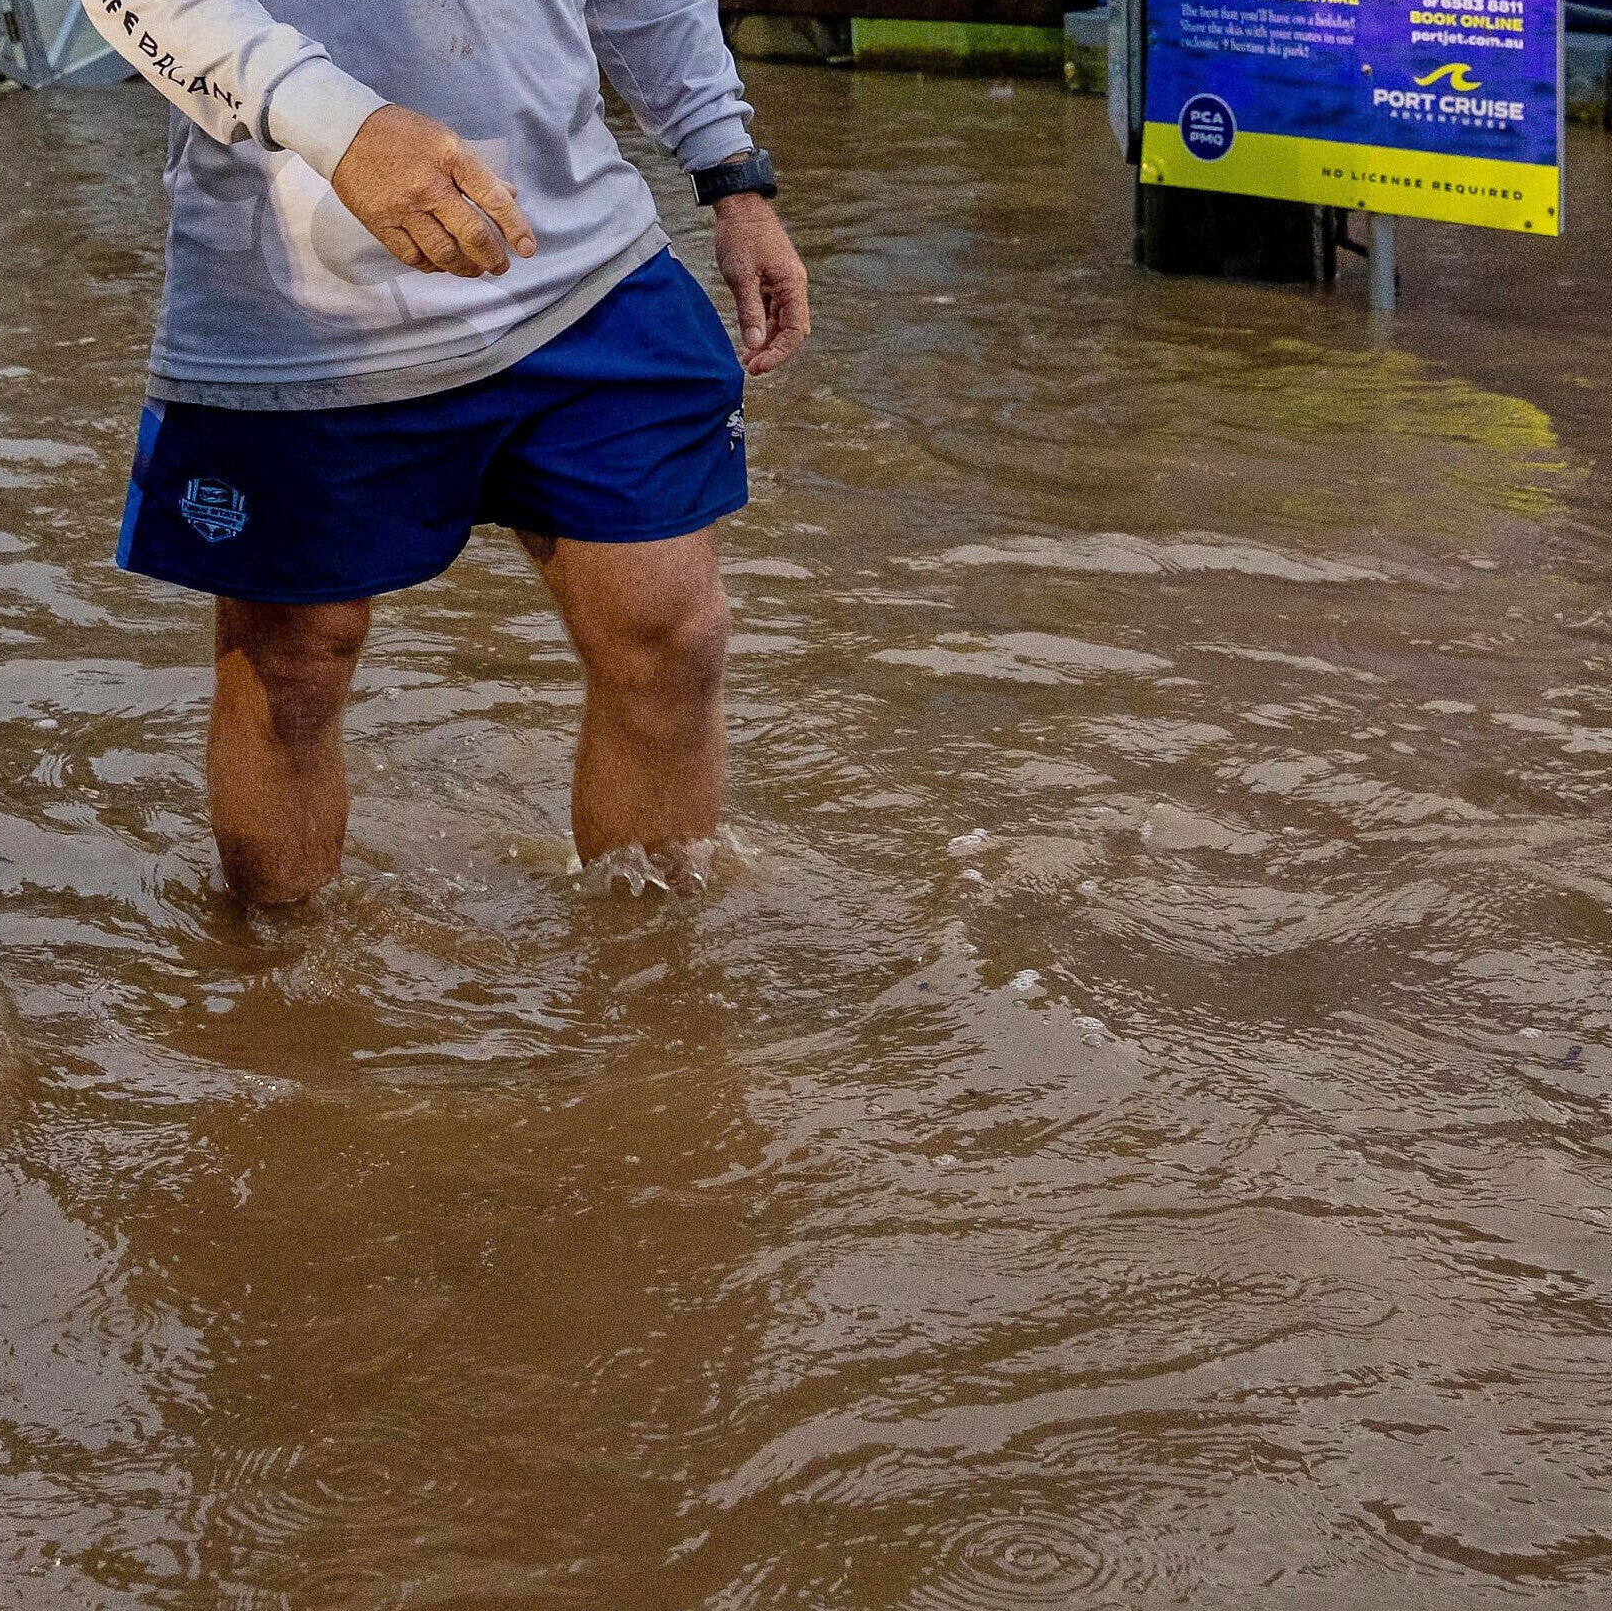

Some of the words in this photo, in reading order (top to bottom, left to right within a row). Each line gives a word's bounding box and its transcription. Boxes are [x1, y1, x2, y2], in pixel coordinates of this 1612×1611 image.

[1410, 10, 1456, 26] BOOK
[1460, 14, 1523, 32] ONLINE
[1411, 30, 1523, 49] portjet.com.au
[1373, 89, 1436, 111] PORT
[1440, 95, 1524, 121] CRUISE
[1190, 110, 1223, 124] PCA
[1321, 167, 1343, 178] NO
[1351, 172, 1423, 188] LICENSE
[1432, 181, 1523, 201] REQUIRED
